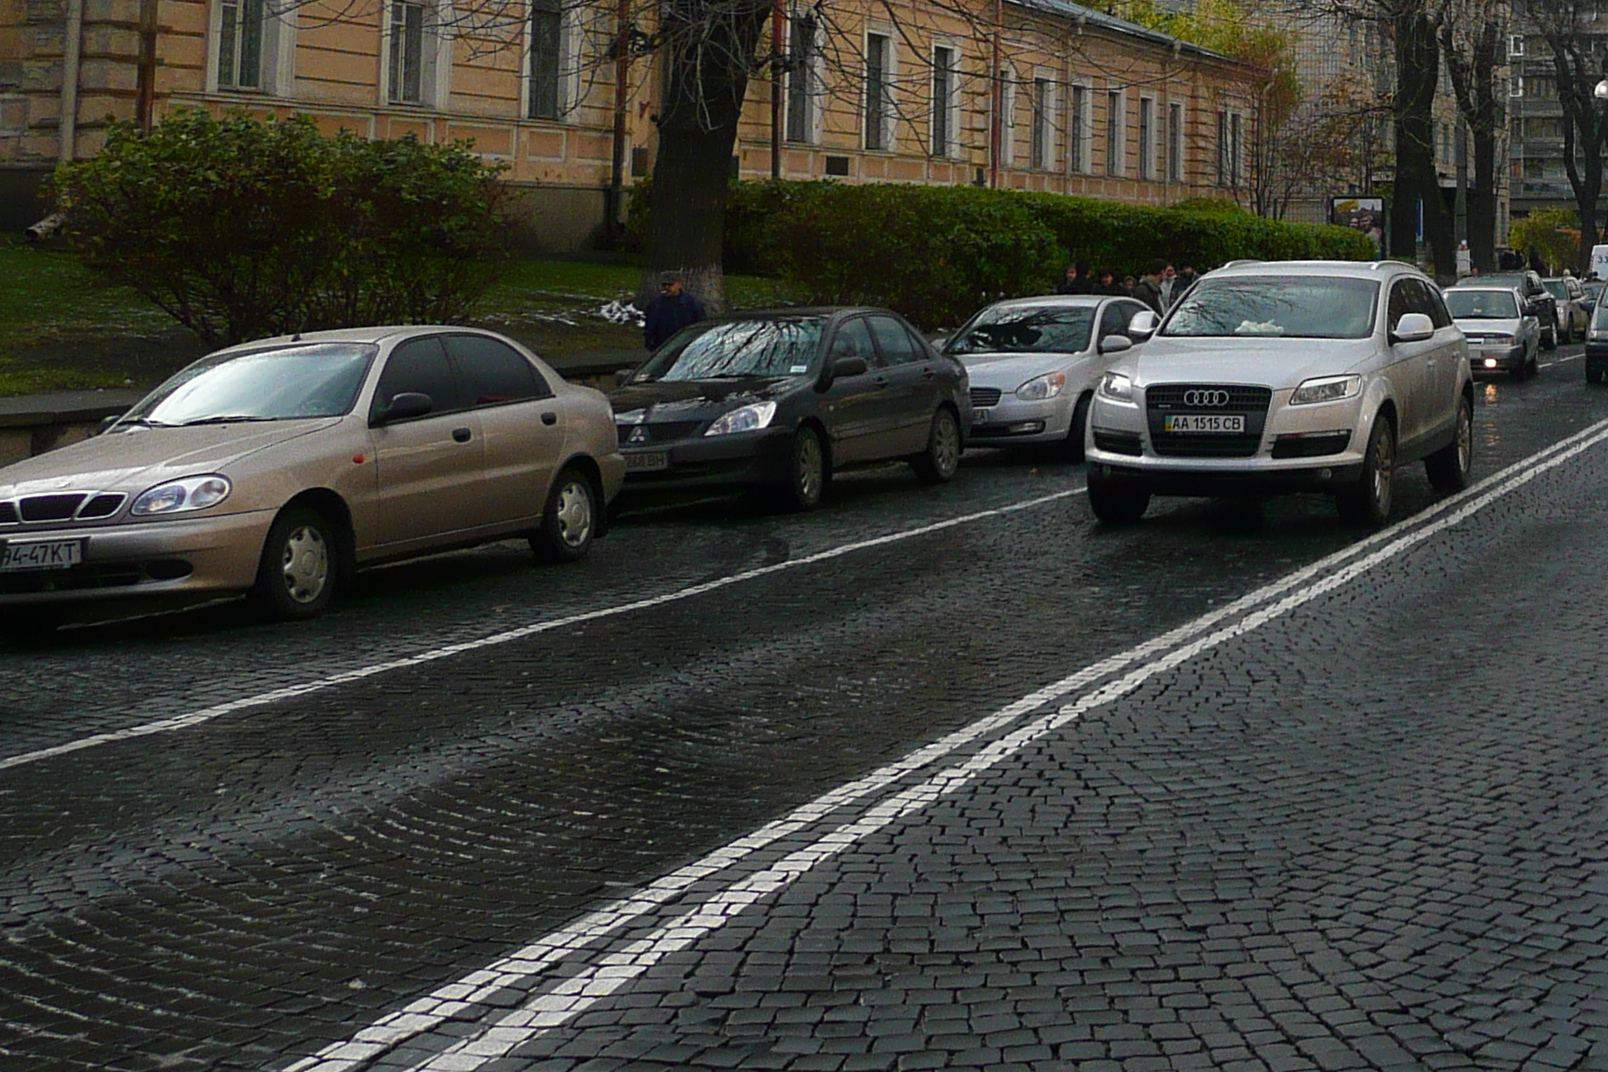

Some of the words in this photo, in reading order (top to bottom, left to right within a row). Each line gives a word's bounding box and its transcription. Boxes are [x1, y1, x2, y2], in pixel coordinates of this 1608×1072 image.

[1172, 417, 1189, 429] AA
[1194, 417, 1220, 429] 1515
[1223, 417, 1241, 429] CB
